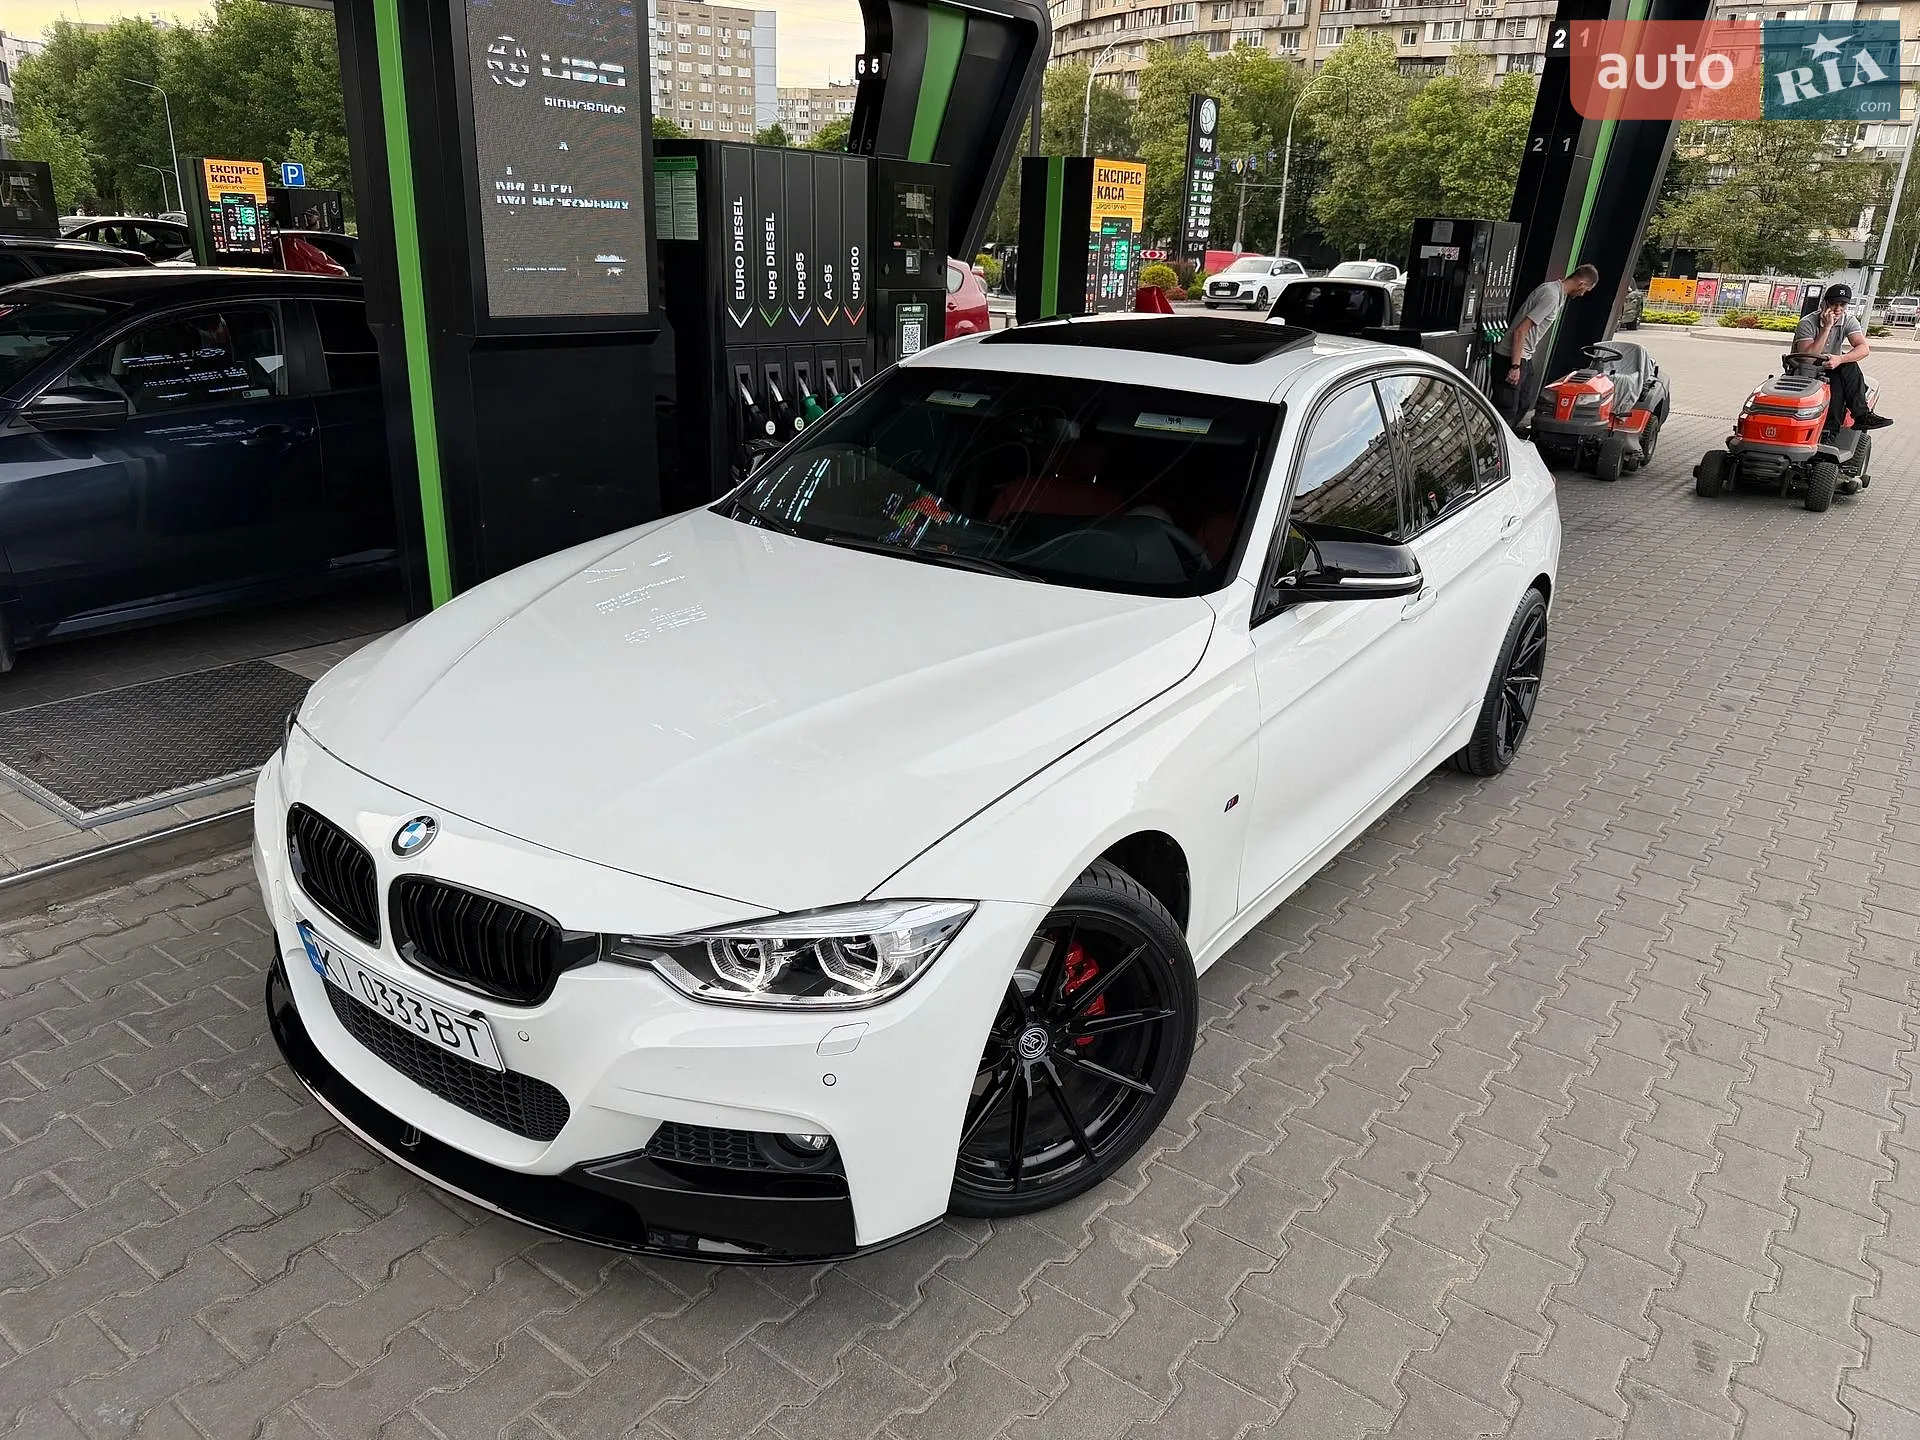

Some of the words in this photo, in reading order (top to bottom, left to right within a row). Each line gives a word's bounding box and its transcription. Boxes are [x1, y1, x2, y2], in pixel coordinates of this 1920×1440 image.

[1553, 29, 1568, 50] 2
[1579, 27, 1591, 48] 1
[858, 59, 866, 74] 6
[871, 58, 879, 74] 5
[851, 140, 858, 150] 6
[866, 139, 872, 150] 5
[1532, 137, 1544, 152] 2
[1562, 137, 1571, 152] 1
[209, 164, 260, 176] ЕКСПРЕС
[211, 174, 243, 184] КАСА
[287, 166, 299, 184] P
[1097, 168, 1142, 185] ЕКСПРЕС
[1096, 186, 1125, 201] КАСА
[733, 196, 745, 252] DIESEL
[765, 212, 776, 267] DIESEL
[735, 255, 745, 300] EURO
[795, 252, 807, 300] upg95
[823, 264, 833, 300] A-95
[850, 246, 861, 300] upg100
[768, 270, 778, 300] upg
